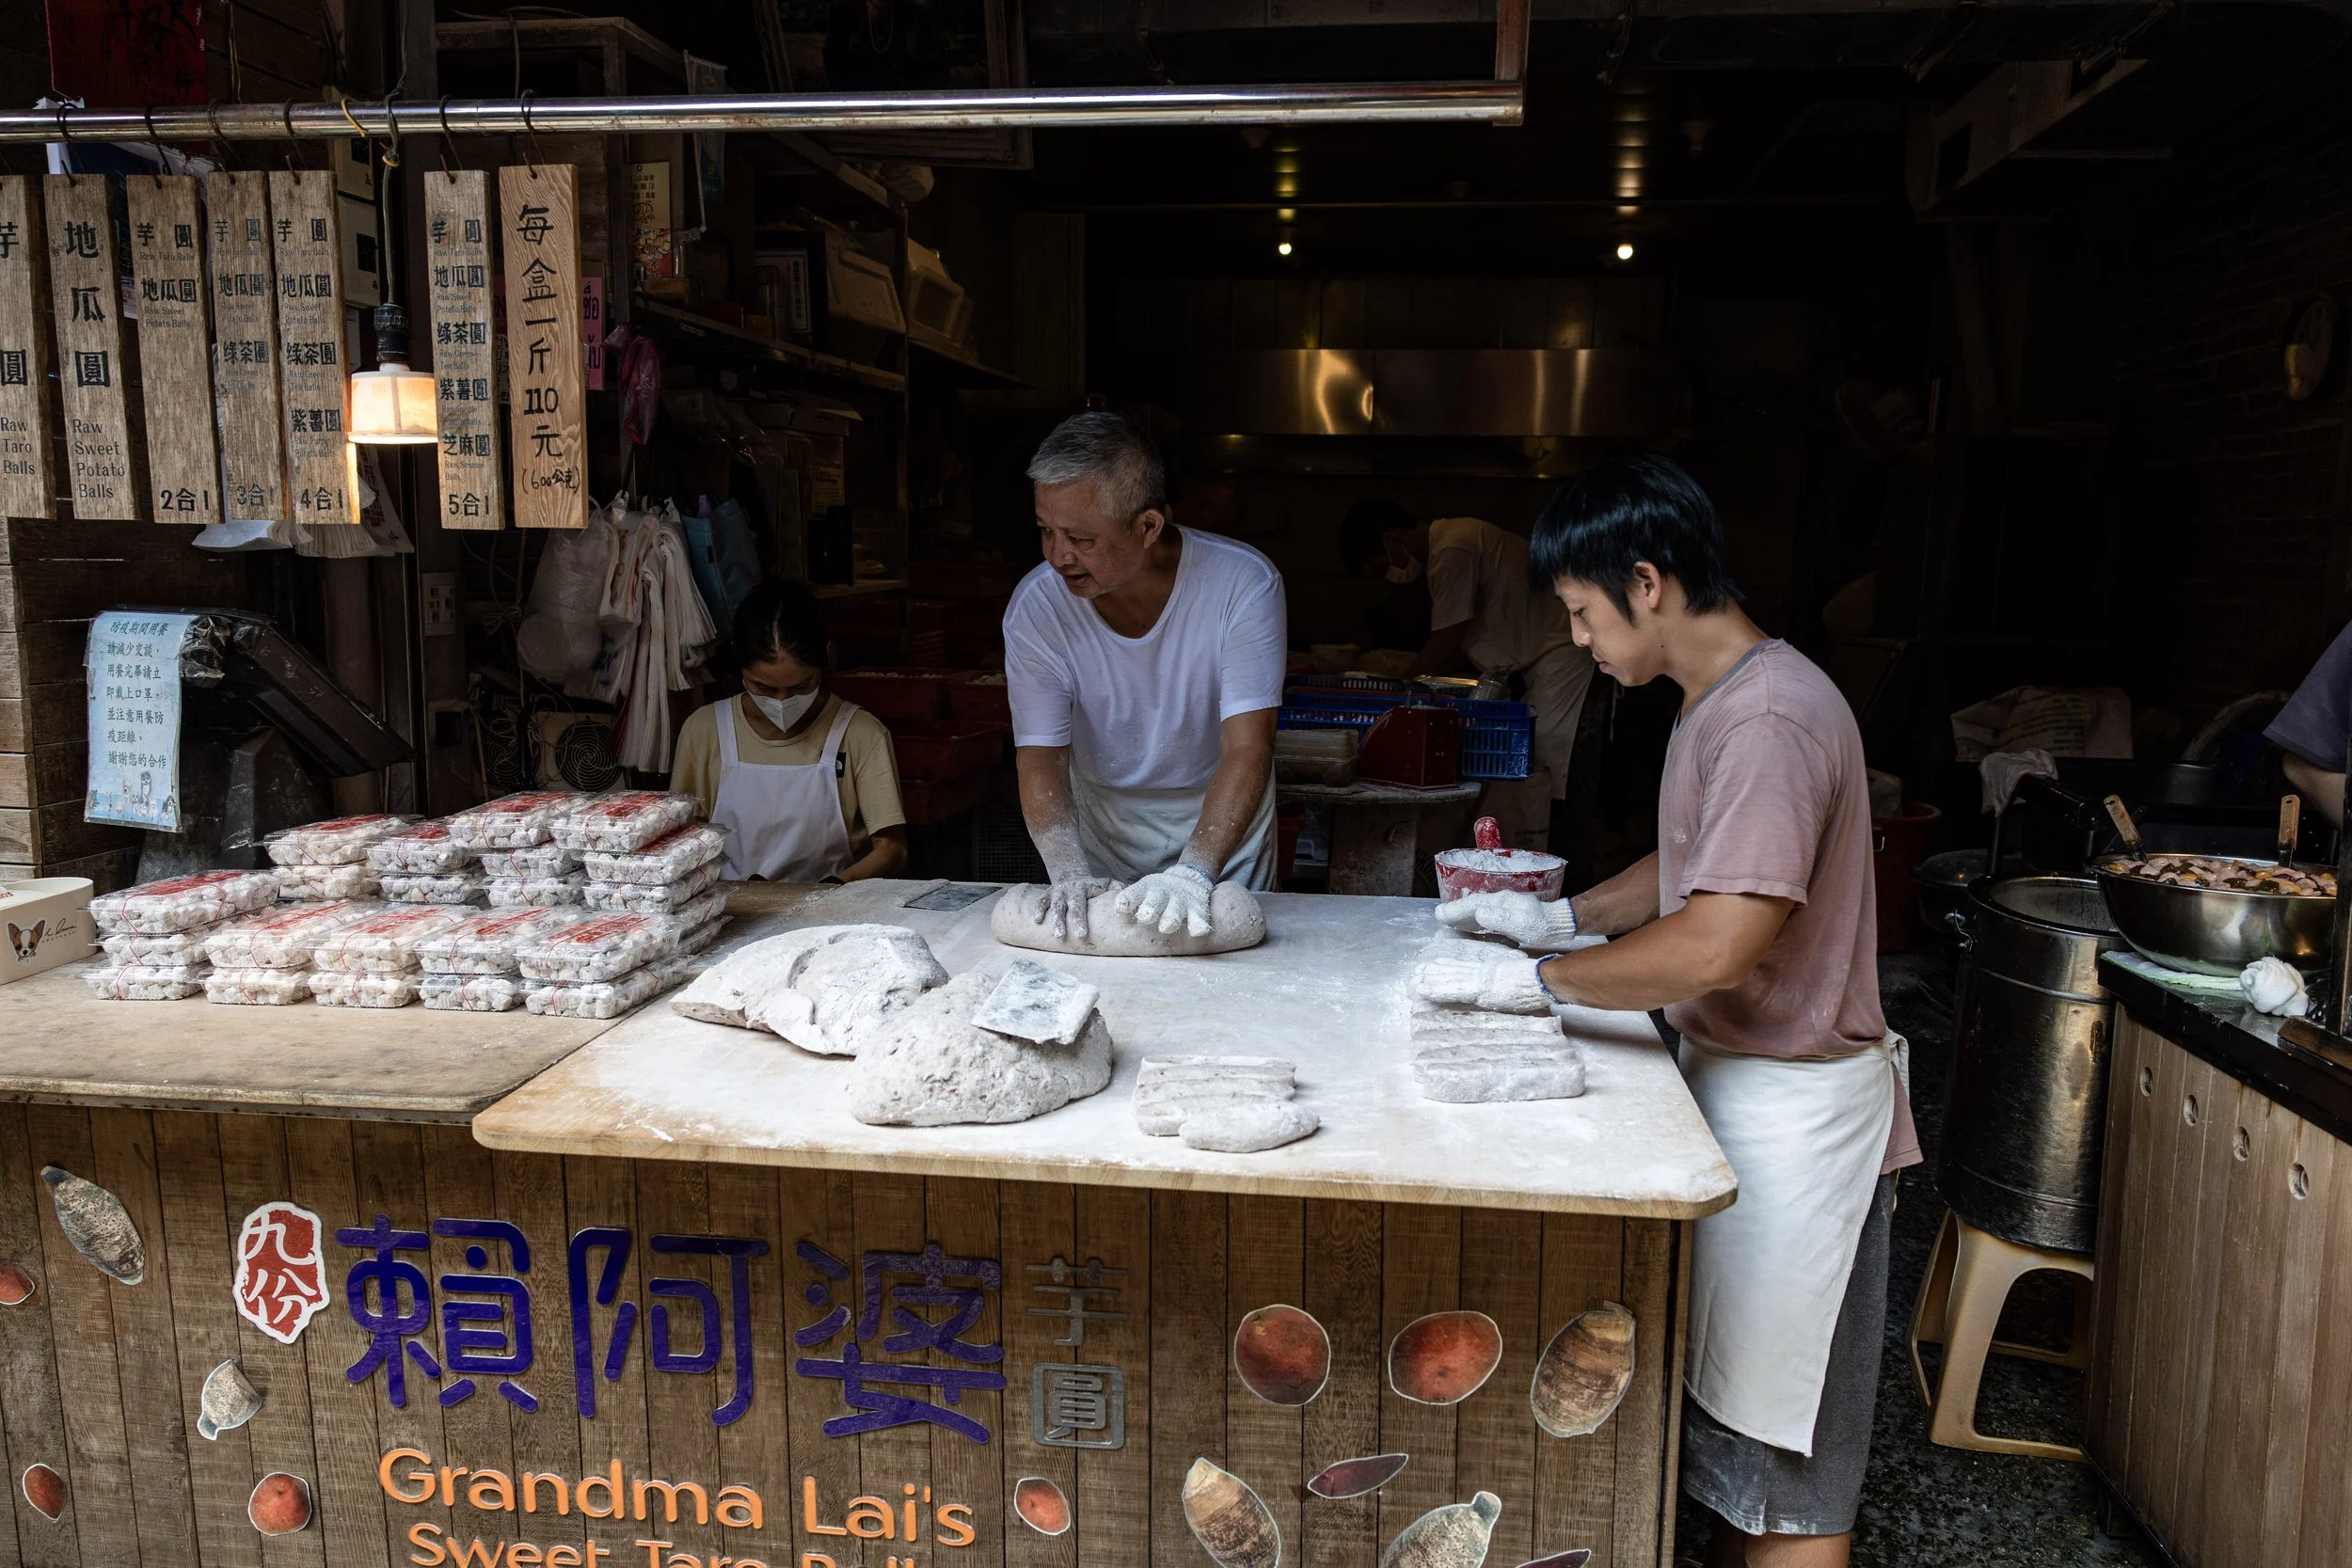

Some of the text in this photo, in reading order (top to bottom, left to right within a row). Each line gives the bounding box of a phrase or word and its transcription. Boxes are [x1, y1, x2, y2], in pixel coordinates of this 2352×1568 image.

[140, 251, 196, 261] Raw Taro Balls
[434, 264, 485, 288] 地瓜圓
[141, 277, 197, 303] 地瓜圓
[218, 273, 264, 297] 地瓜圓
[281, 274, 332, 298] 地瓜圓
[64, 220, 111, 388] 地瓜圓
[452, 293, 472, 301] Sweet
[145, 306, 185, 316] Raw Sweet
[300, 303, 321, 312] Sweet
[437, 305, 459, 314] Potato
[146, 319, 191, 329] Potato Balls
[285, 315, 309, 325] Potato
[437, 321, 486, 345] 綠茶圓
[286, 341, 337, 366] 綠茶圓
[305, 369, 326, 378] Green
[304, 382, 321, 391] Balls
[1, 417, 27, 432] Raw
[72, 419, 103, 433] Raw
[3, 438, 33, 453] Taro
[74, 440, 120, 455] Sweet
[442, 433, 491, 457] 芝麻圓
[4, 459, 36, 475] Balls
[76, 462, 125, 477] Potato
[79, 483, 114, 499] Balls
[160, 487, 209, 512] 2合1
[110, 621, 169, 637] 防疫期間用餐
[107, 751, 167, 769] 謝謝您的合作
[244, 1212, 318, 1328] 九份
[334, 1213, 1008, 1445] 賴阿婆
[378, 1447, 977, 1546] Grandma Lai's
[407, 1522, 611, 1568] Sweet
